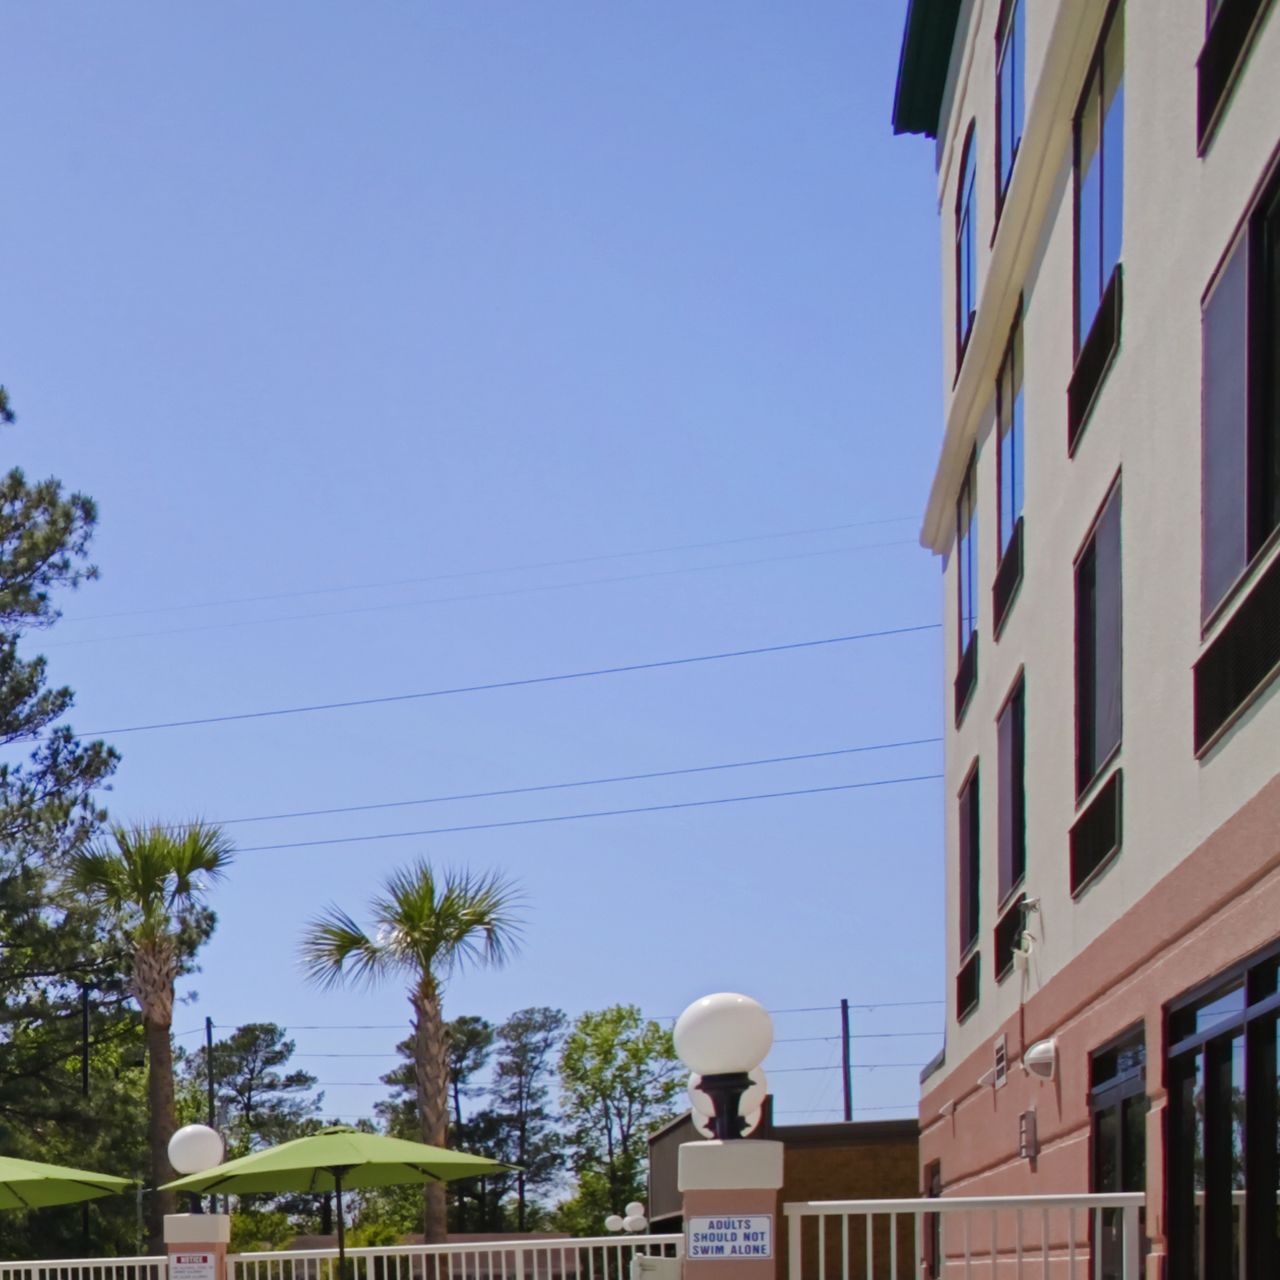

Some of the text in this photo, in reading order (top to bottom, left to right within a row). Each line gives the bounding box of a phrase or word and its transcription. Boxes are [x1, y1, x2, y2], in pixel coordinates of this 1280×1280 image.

[708, 1219, 751, 1229] ADULTS
[693, 1231, 765, 1242] SHOULD NOT
[692, 1244, 767, 1255] SWIM ALONE
